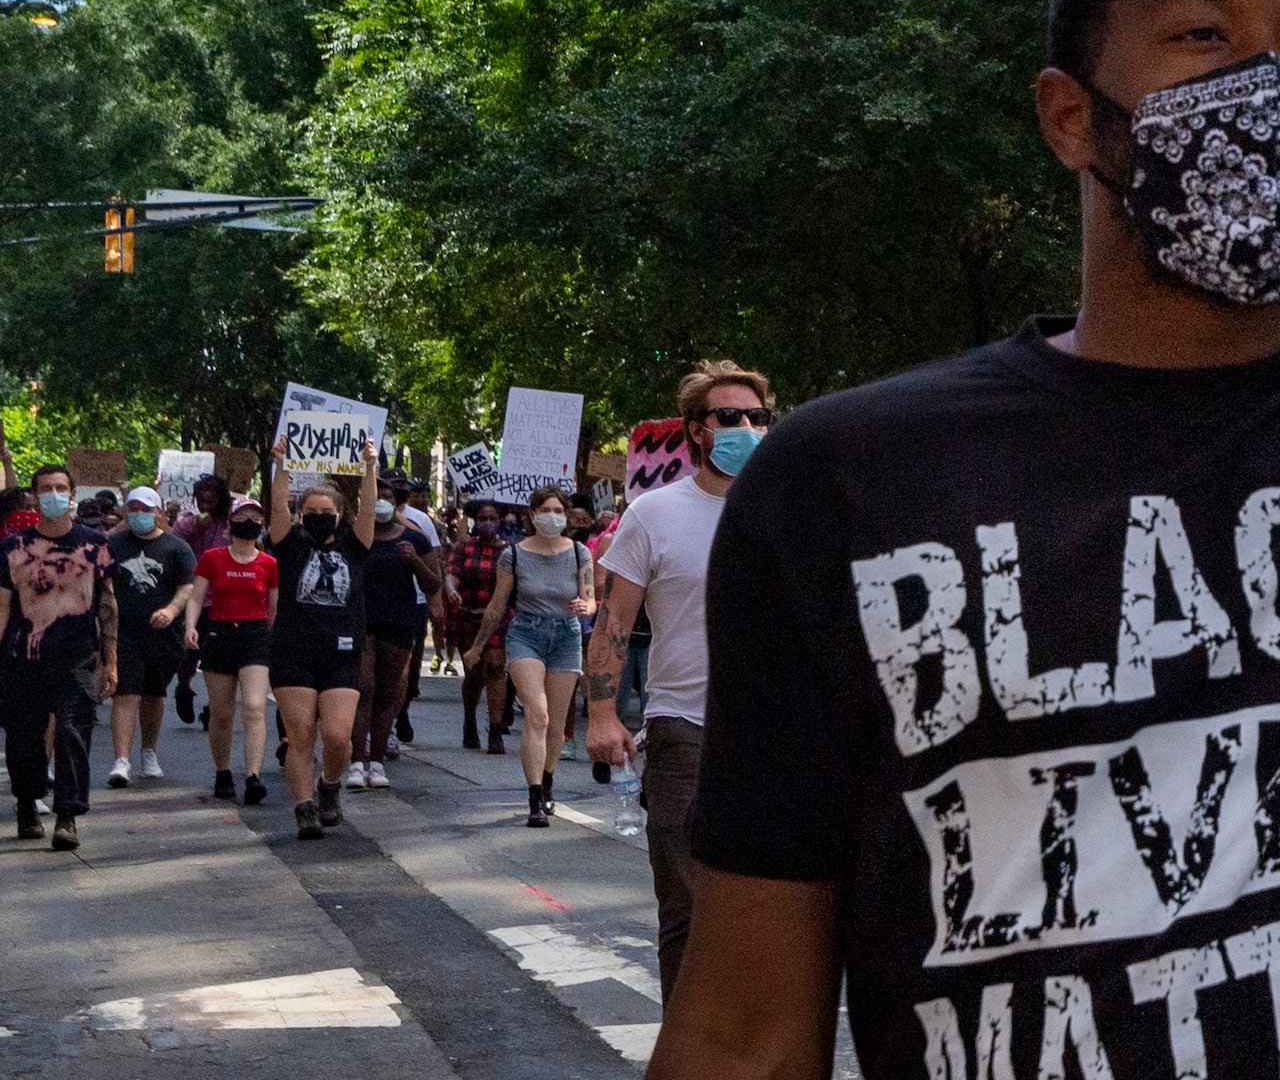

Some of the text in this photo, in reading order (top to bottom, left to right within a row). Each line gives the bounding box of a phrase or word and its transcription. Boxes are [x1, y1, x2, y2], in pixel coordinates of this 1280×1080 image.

[286, 422, 367, 463] RAYSHARD
[634, 429, 685, 455] NO
[287, 459, 366, 475] SAY HIS NAME
[449, 448, 487, 473] BLACK
[460, 471, 500, 496] MATTER
[628, 458, 683, 491] NO
